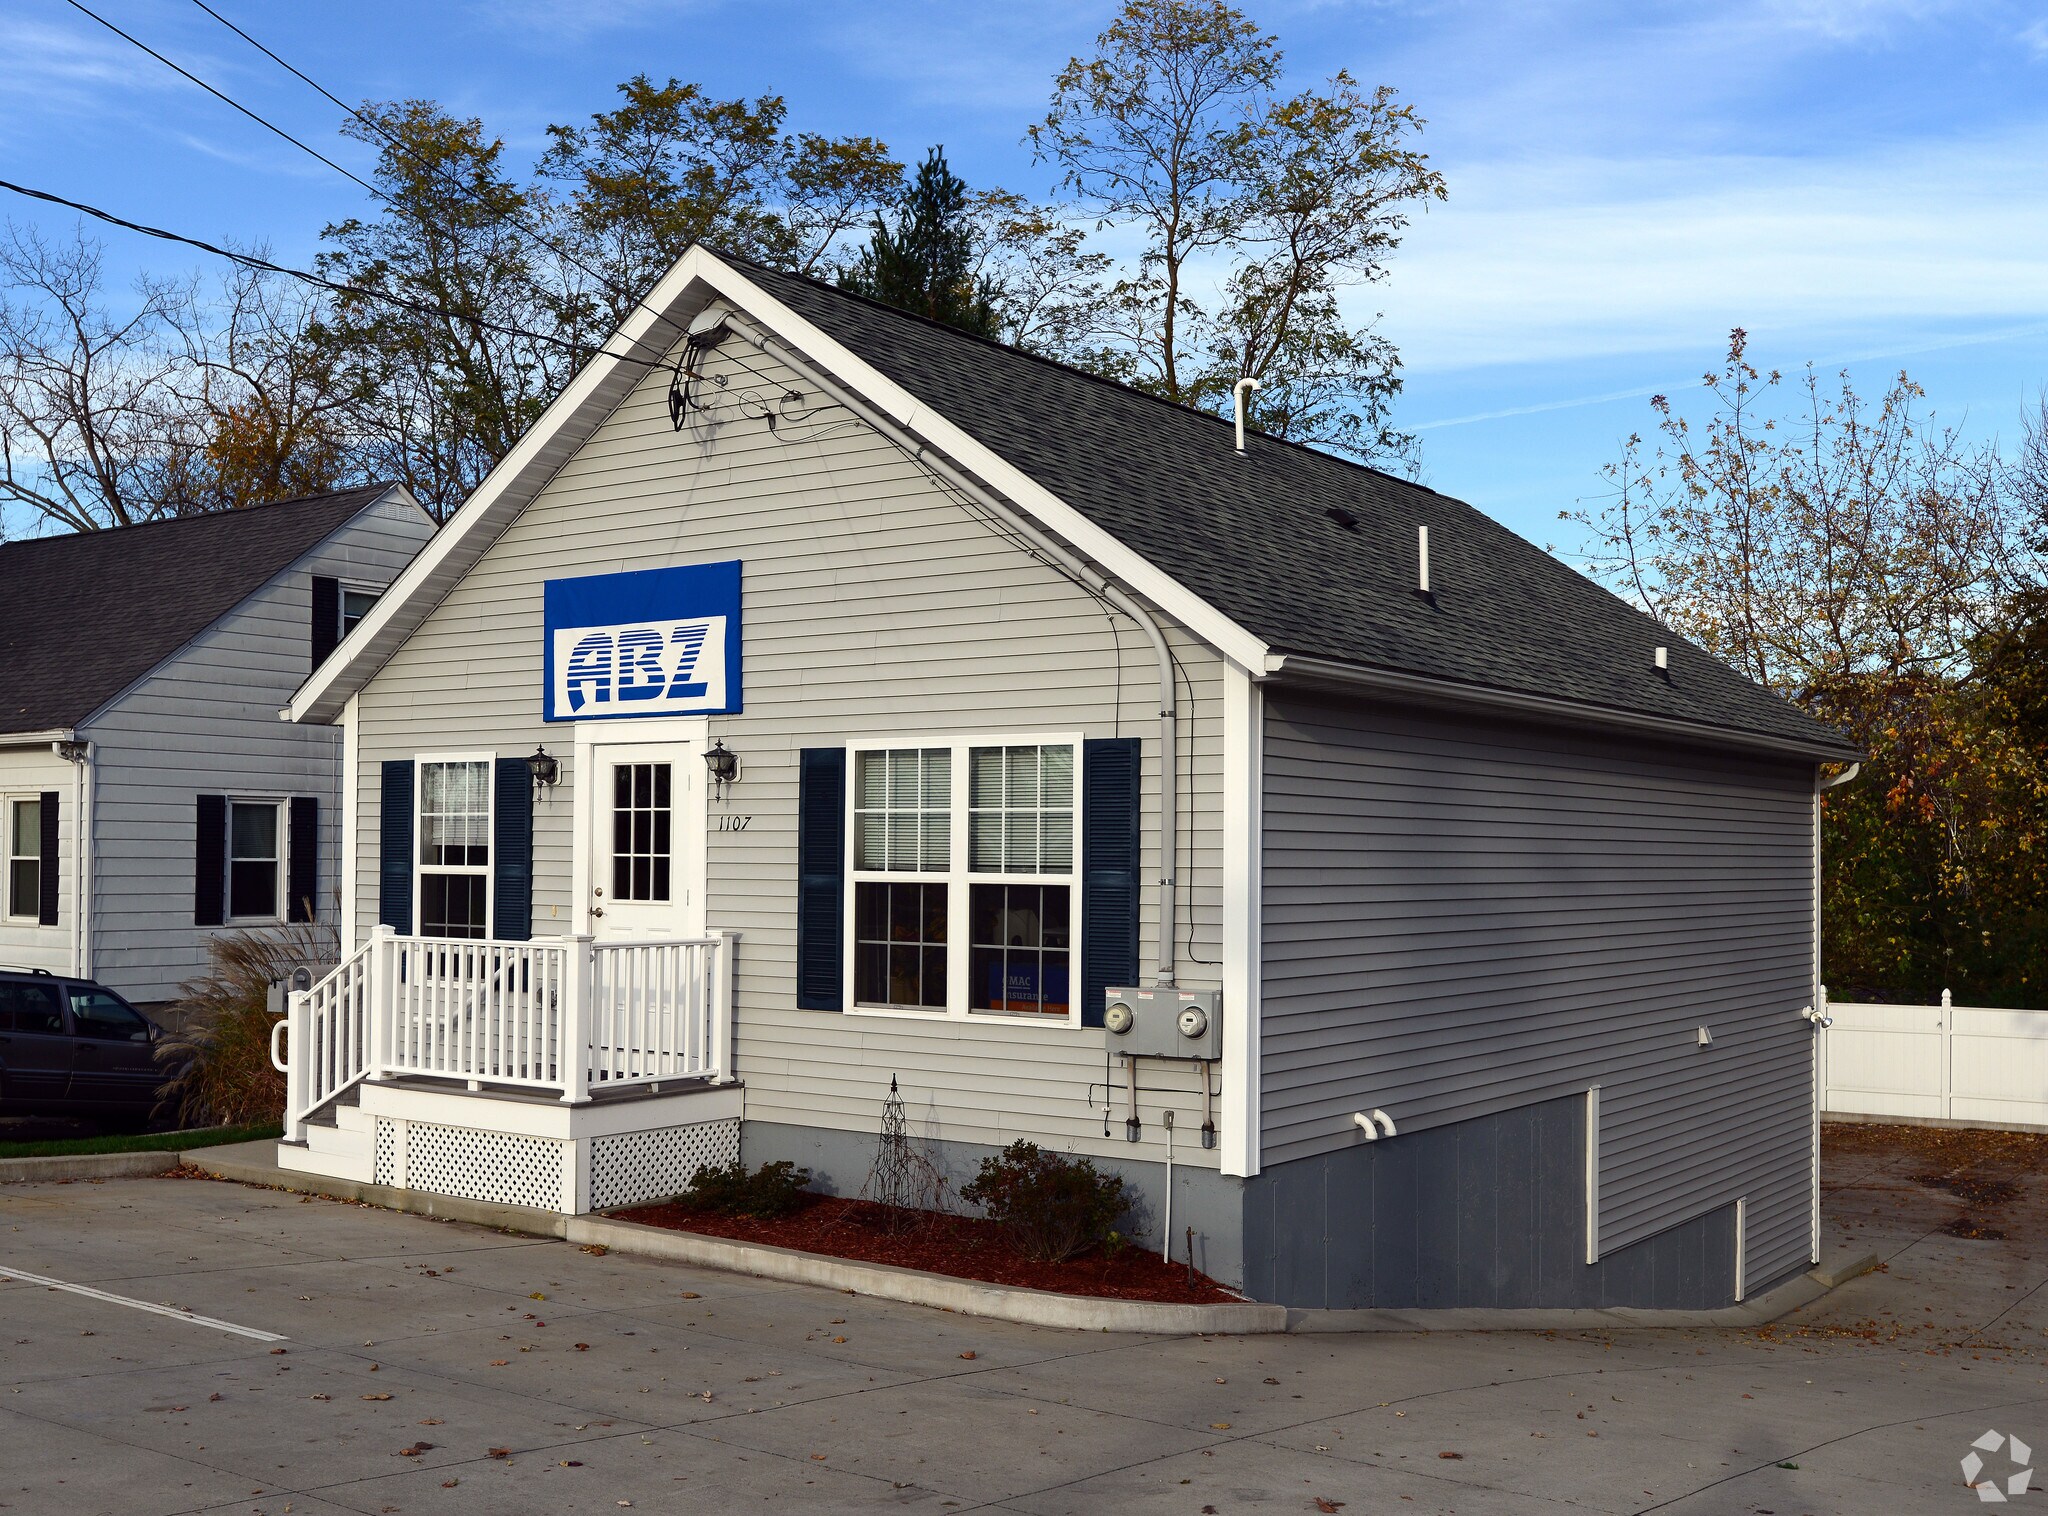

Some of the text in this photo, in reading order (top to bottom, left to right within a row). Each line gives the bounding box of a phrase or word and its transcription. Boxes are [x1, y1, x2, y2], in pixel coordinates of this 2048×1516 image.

[567, 624, 710, 713] ABZ
[719, 816, 752, 832] 1107
[1002, 990, 1049, 1001] nsurane
